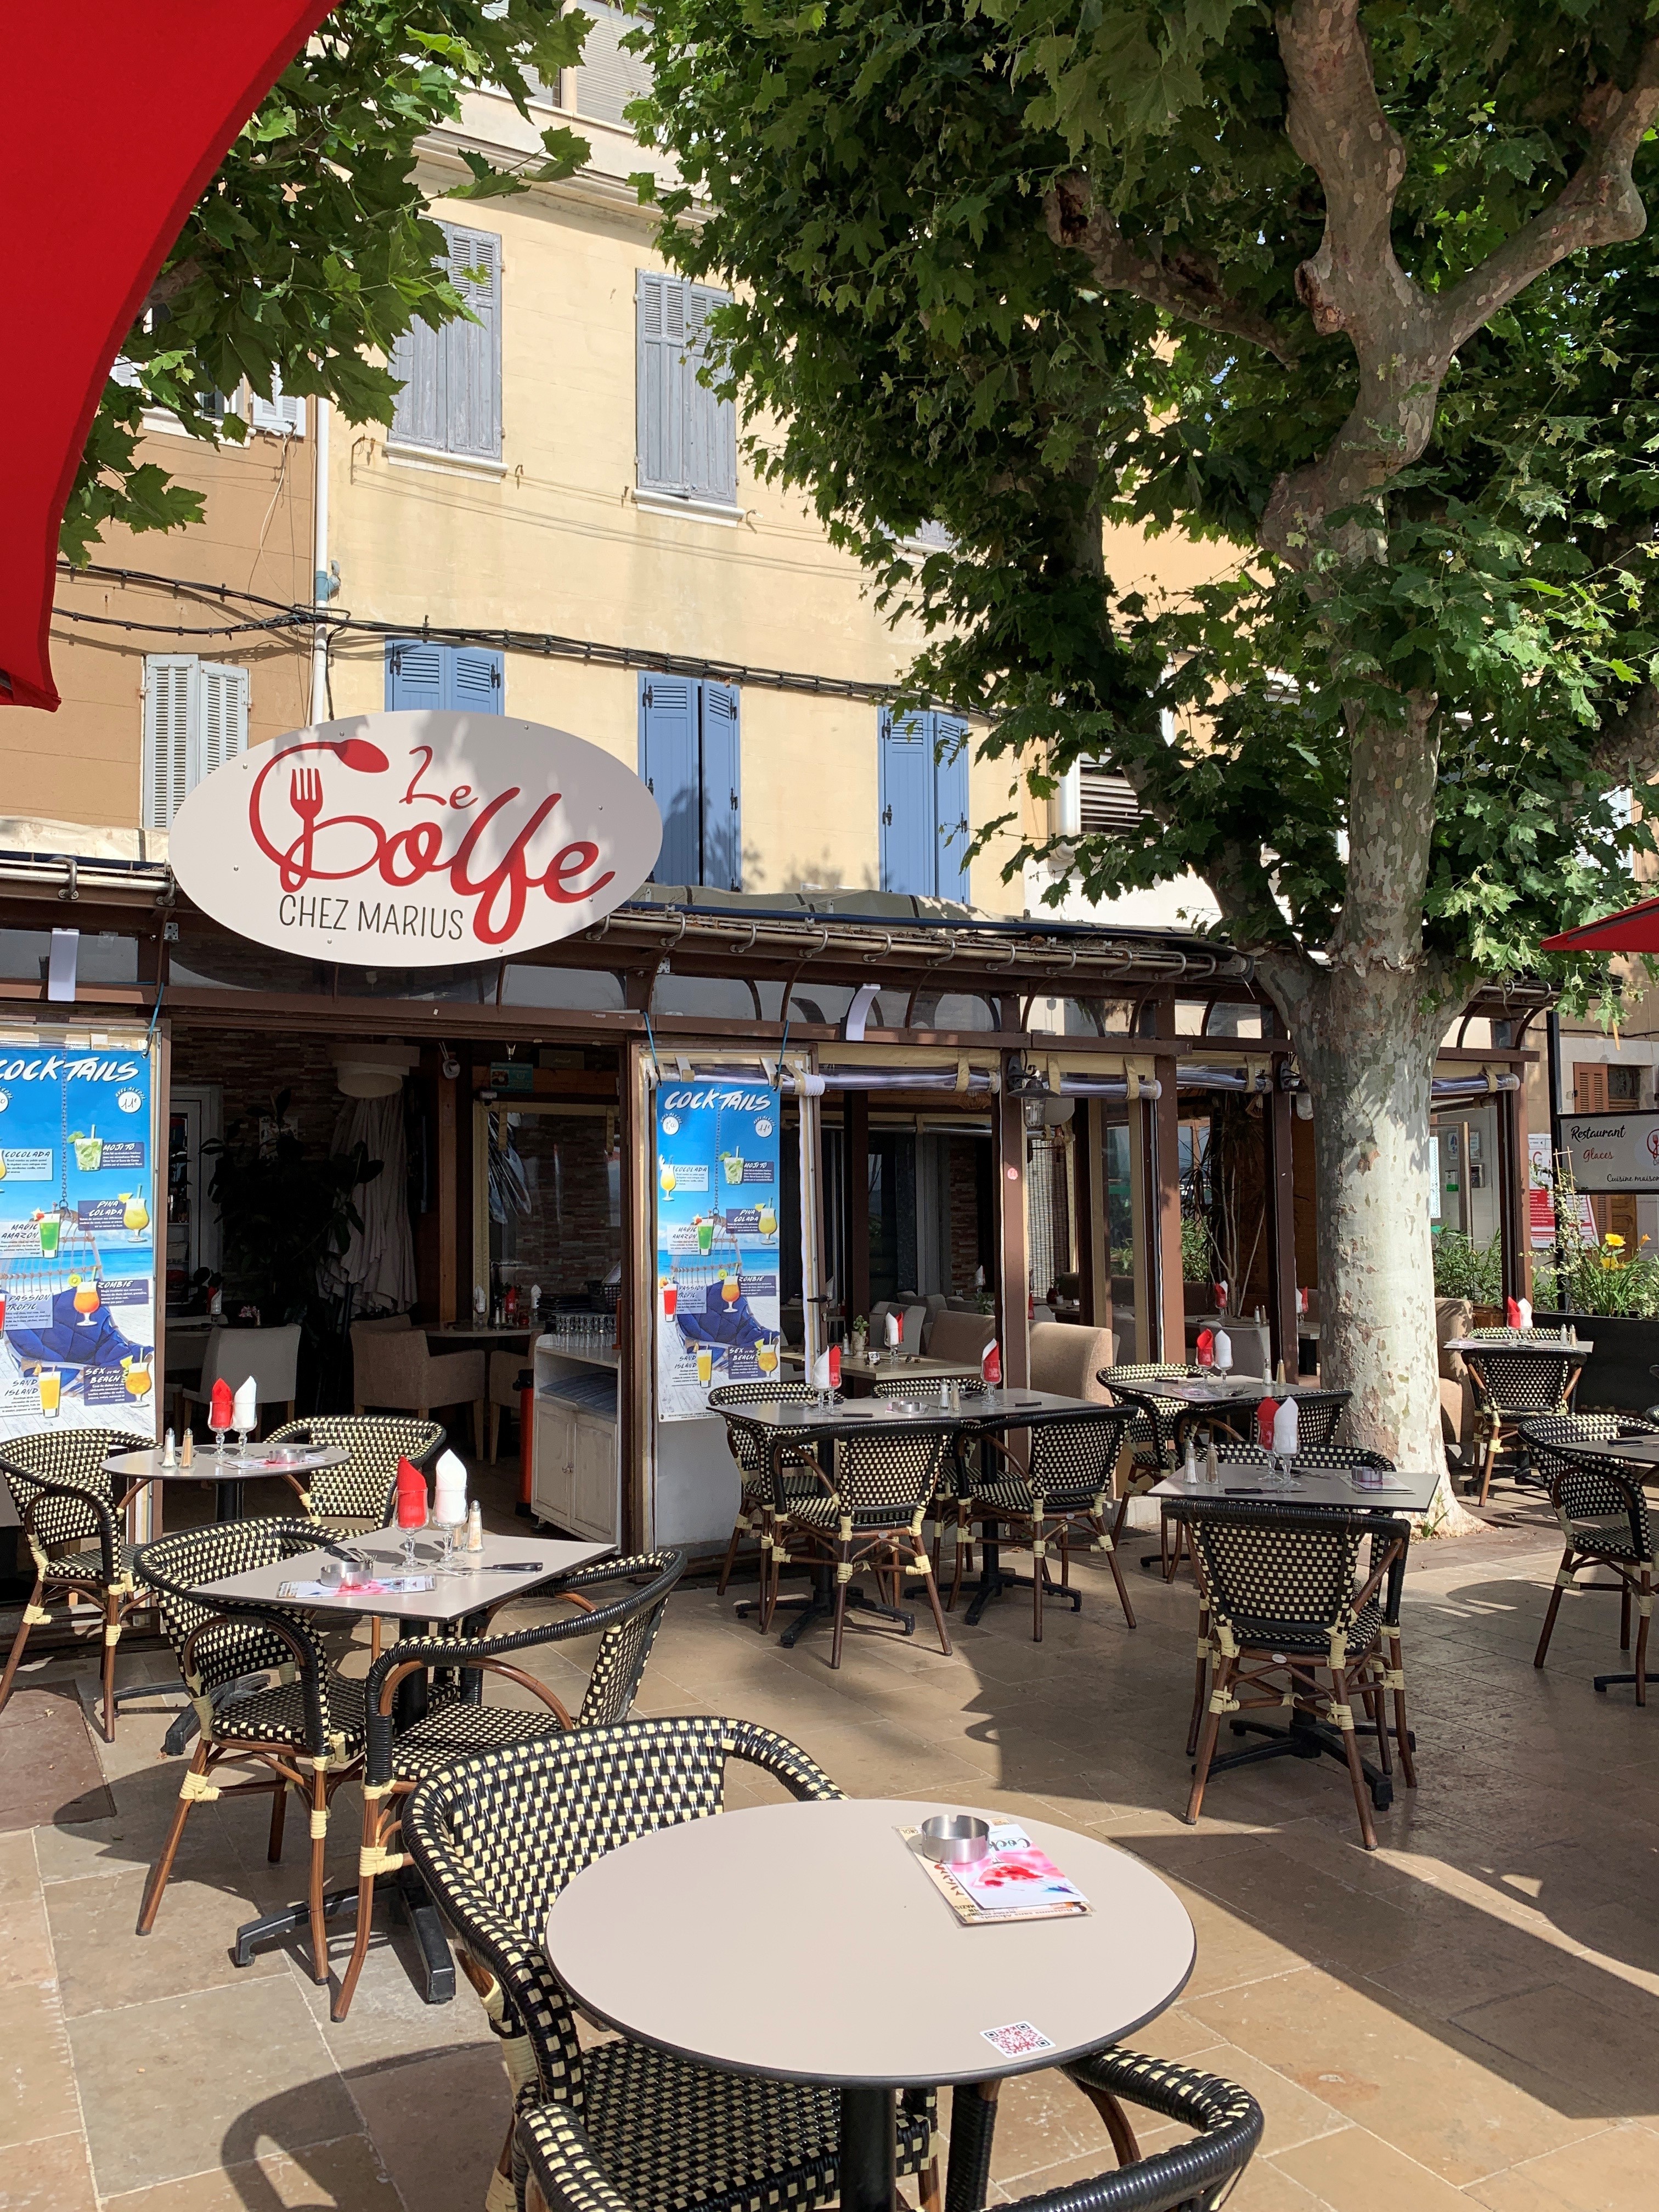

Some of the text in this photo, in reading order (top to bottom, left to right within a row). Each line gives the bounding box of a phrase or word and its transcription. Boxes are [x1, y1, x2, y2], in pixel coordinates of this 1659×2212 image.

[399, 746, 478, 809] Le
[249, 739, 616, 945] Golfe
[279, 894, 463, 940] CHEZ MARIUS
[664, 1088, 771, 1111] COCKTAILS
[1571, 1125, 1626, 1143] Restaurant
[103, 1143, 135, 1151] MOJITO
[1607, 1174, 1633, 1182] Cuisine
[90, 1375, 121, 1384] BEACH
